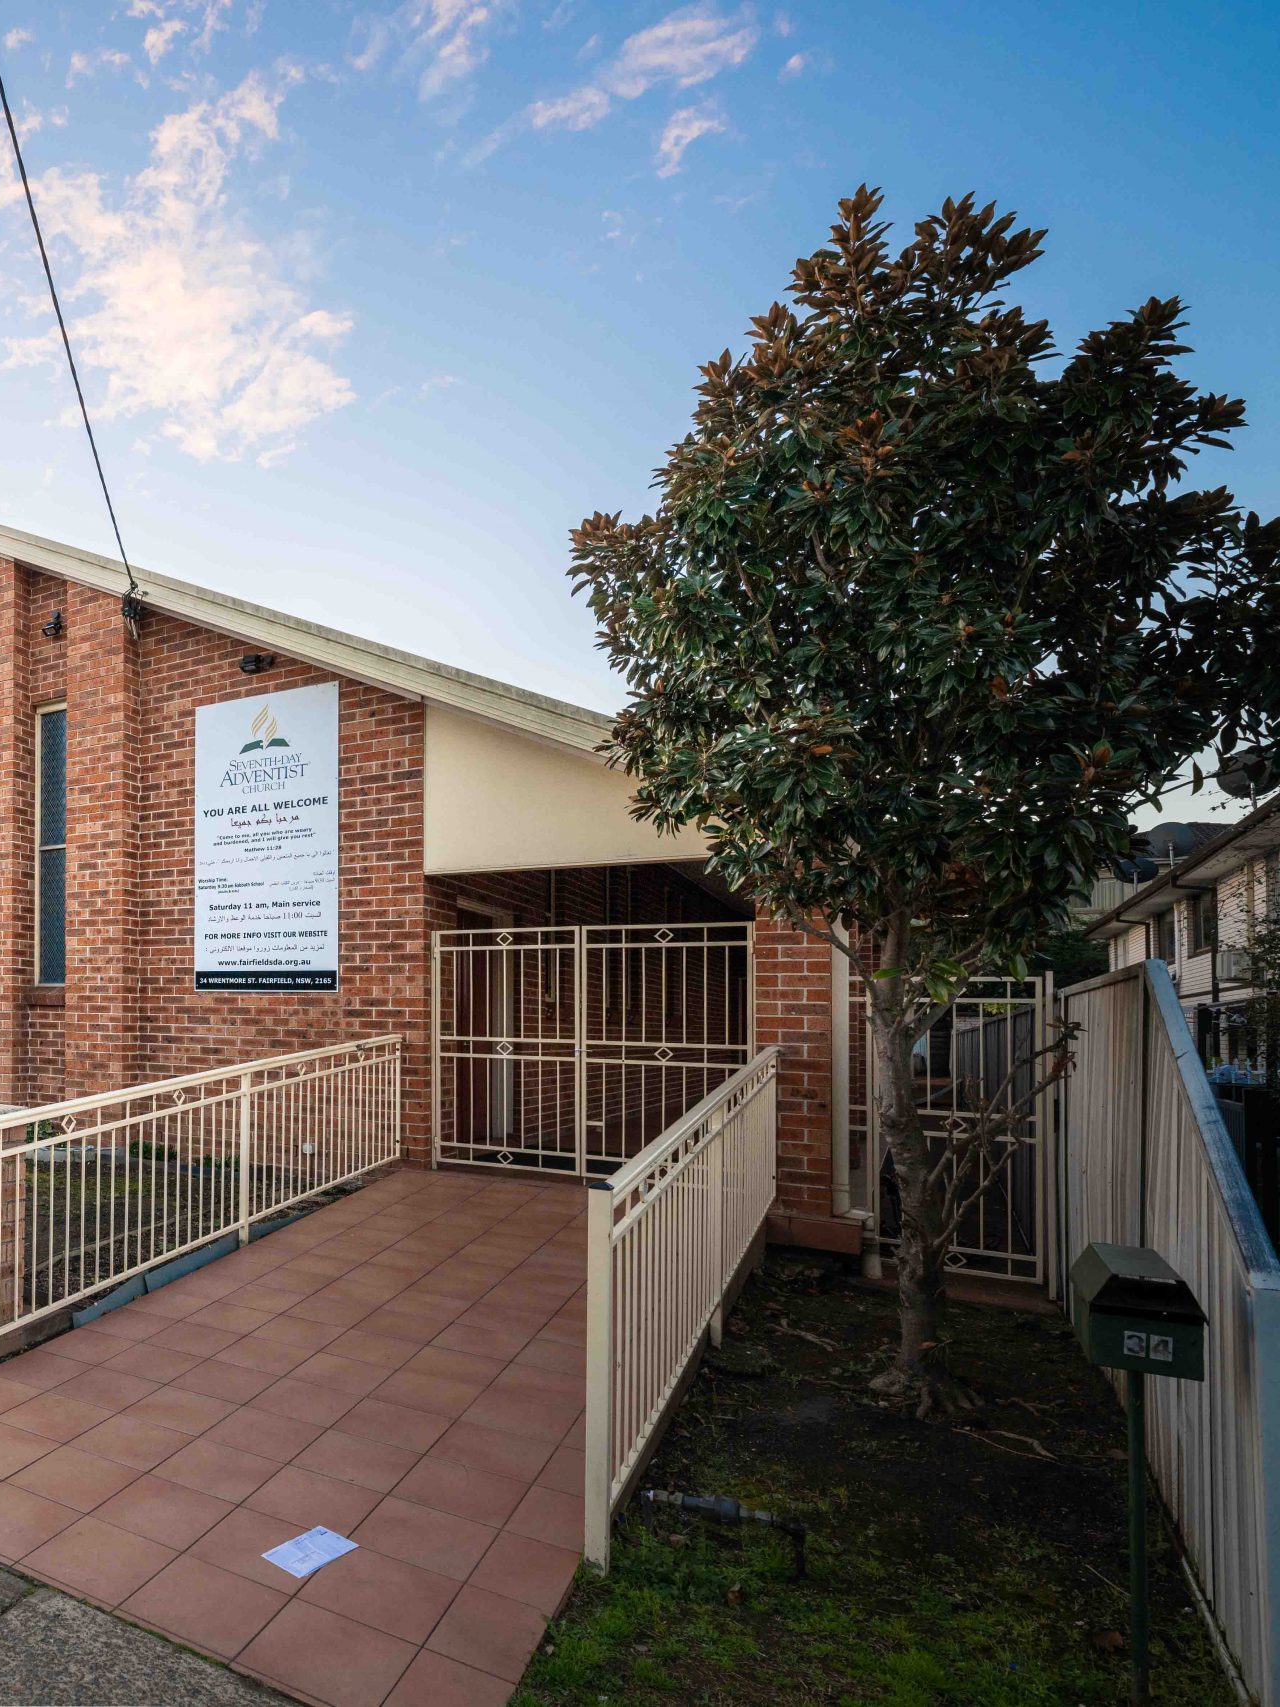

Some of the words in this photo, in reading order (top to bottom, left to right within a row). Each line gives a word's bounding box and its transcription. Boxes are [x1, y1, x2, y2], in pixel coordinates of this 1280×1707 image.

[230, 752, 302, 772] SEVENTH-DAY
[220, 763, 308, 788] ADVENTIST
[242, 781, 286, 795] CHURCH
[203, 808, 224, 818] YOU
[227, 805, 247, 816] ARE
[250, 803, 270, 813] ALL
[273, 796, 329, 810] WELCOME
[209, 903, 242, 911] Saturday
[271, 900, 290, 908] Main
[292, 899, 321, 908] service
[220, 932, 241, 940] MORE
[243, 931, 262, 939] INFO
[263, 931, 282, 939] VISIT
[298, 930, 328, 938] WEBSITE
[218, 957, 311, 966] www.fairfieldsda.org.au
[295, 977, 314, 985] NSW,
